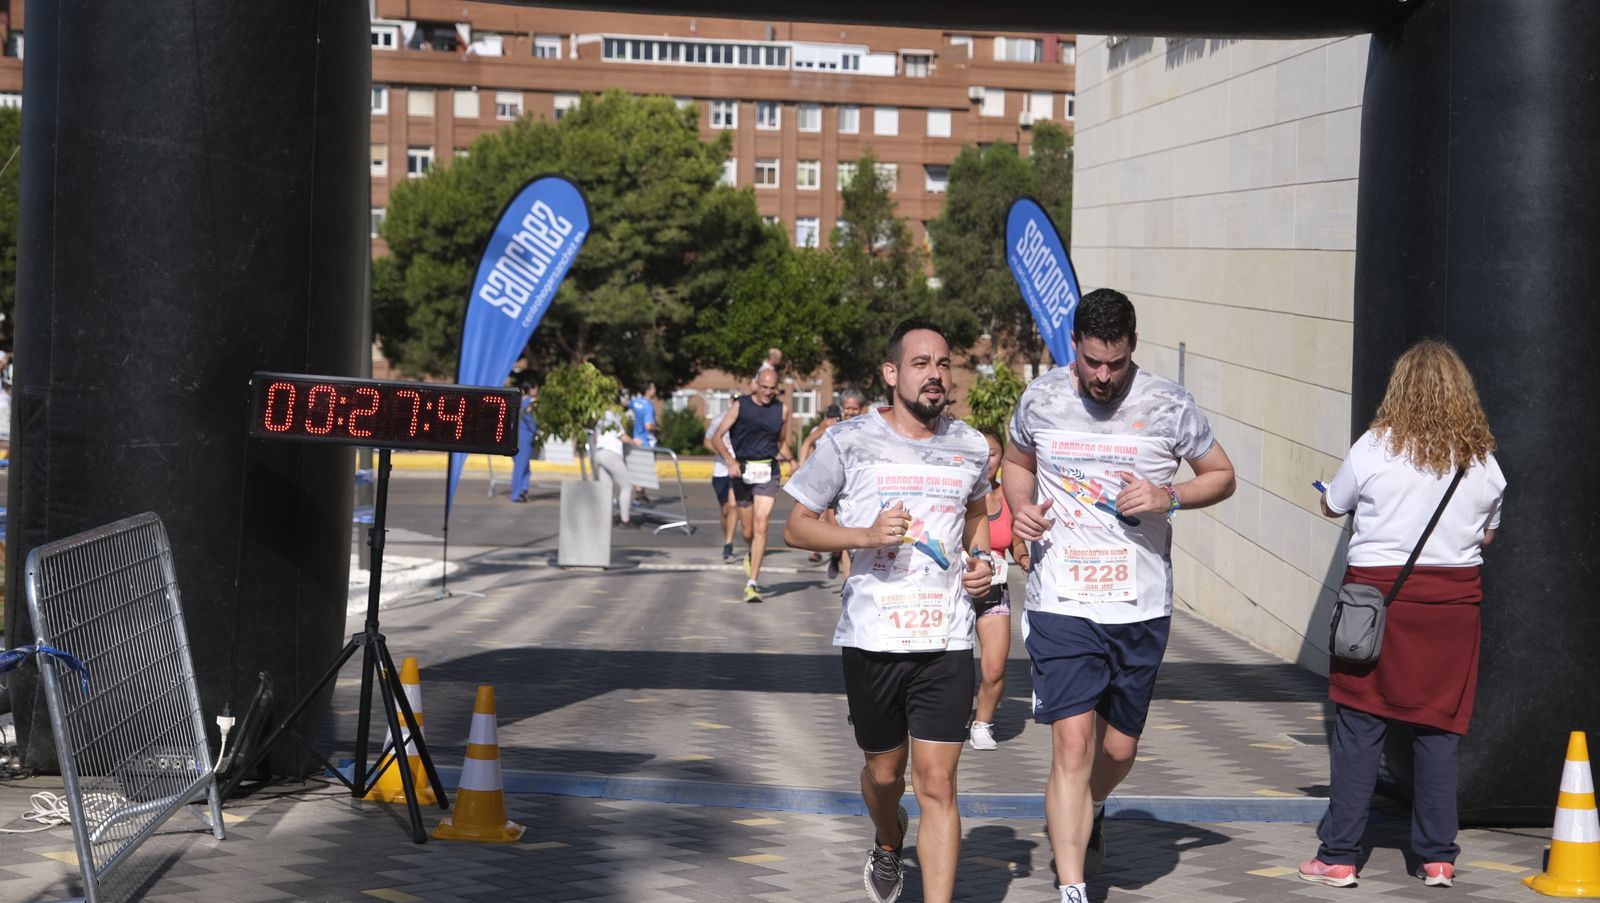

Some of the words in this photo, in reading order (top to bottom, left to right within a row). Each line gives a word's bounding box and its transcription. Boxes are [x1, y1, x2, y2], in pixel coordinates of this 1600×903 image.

[522, 231, 585, 328] centrohogarsanchez.es
[264, 382, 506, 442] 00:27:47
[1059, 441, 1095, 452] CARRERA
[1097, 443, 1112, 453] SIN
[1114, 445, 1138, 455] HUMO
[885, 475, 924, 485] CARRERA
[926, 476, 941, 486] SIN
[942, 476, 963, 488] HUMO
[1069, 564, 1129, 582] 1228
[927, 592, 943, 600] HUMO
[889, 609, 943, 629] 1229
